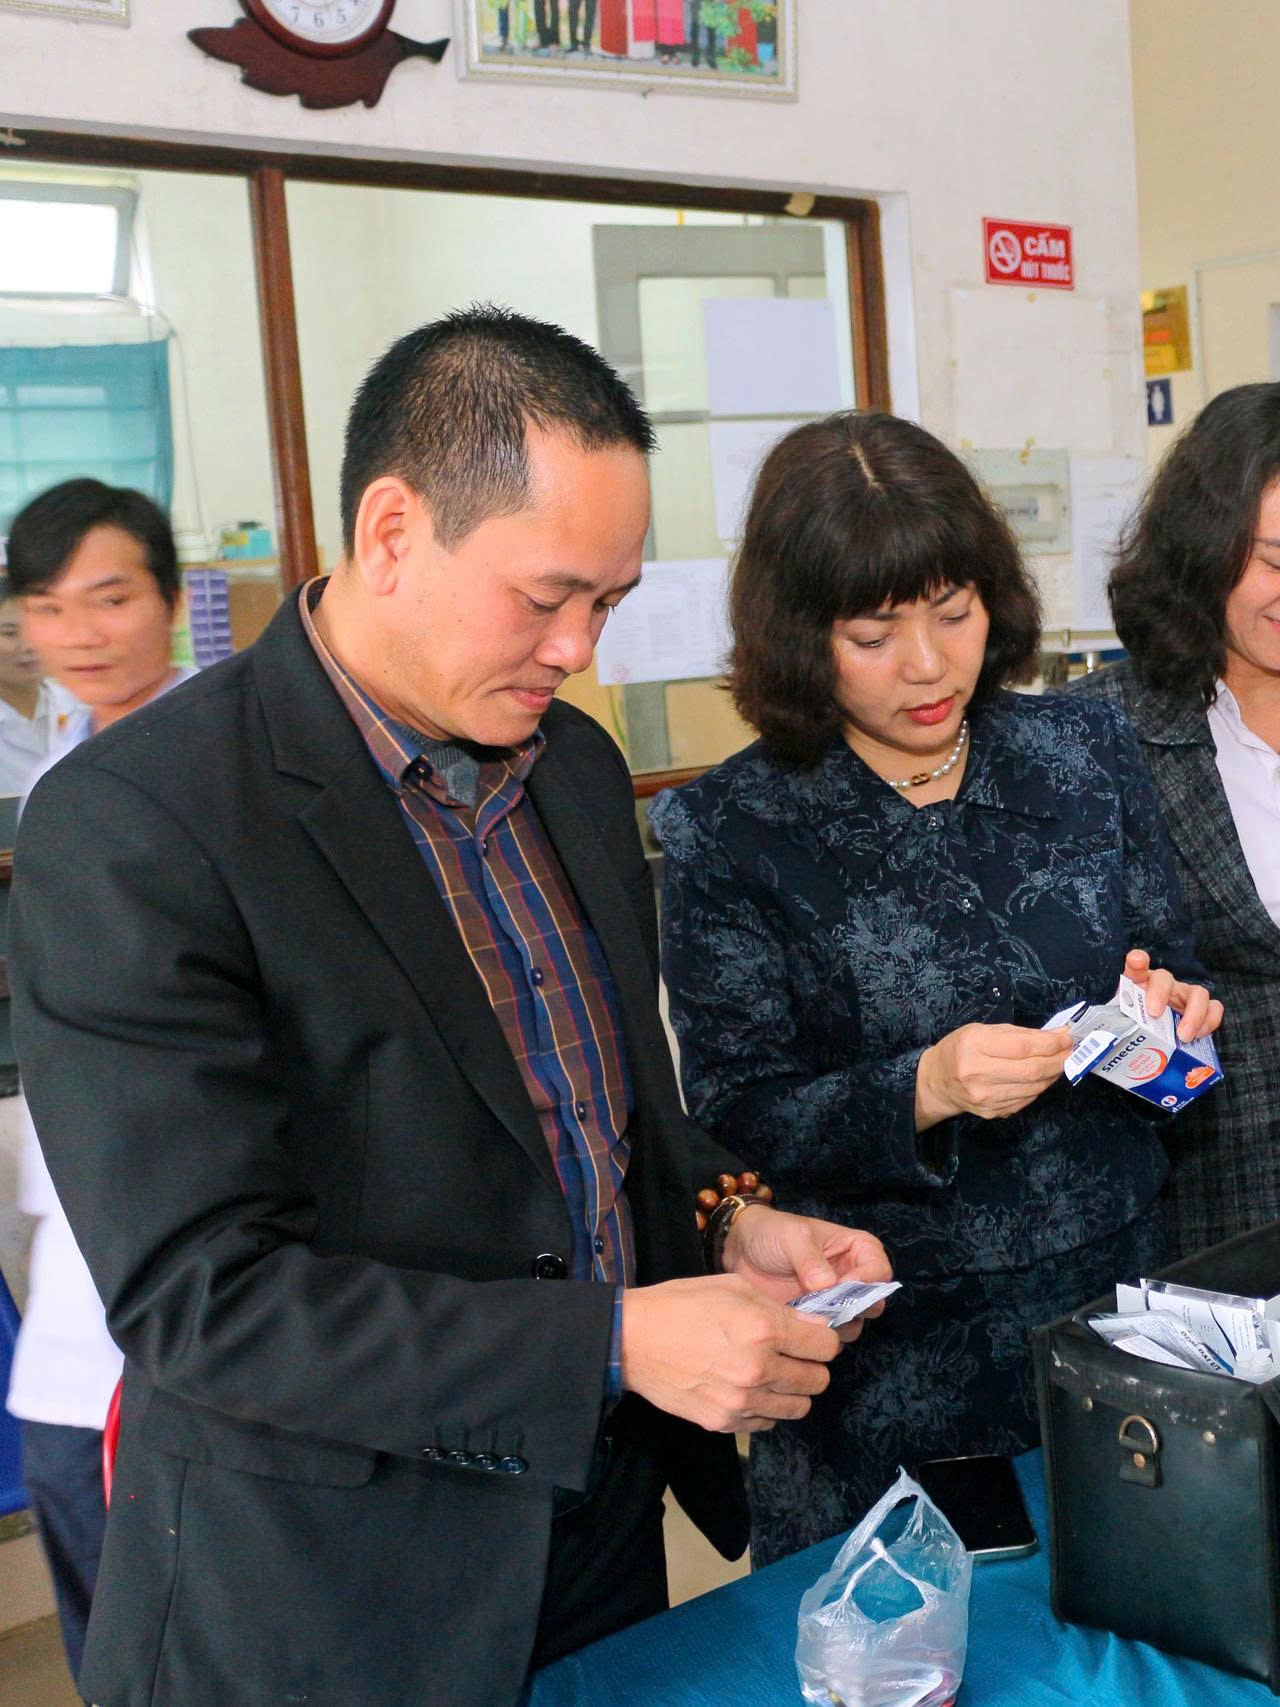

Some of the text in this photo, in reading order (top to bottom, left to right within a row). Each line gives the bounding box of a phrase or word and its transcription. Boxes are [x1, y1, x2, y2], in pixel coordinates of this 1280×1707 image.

[314, 12, 324, 28] 6
[1024, 231, 1065, 257] CẤM
[1102, 1034, 1147, 1073] smecta
